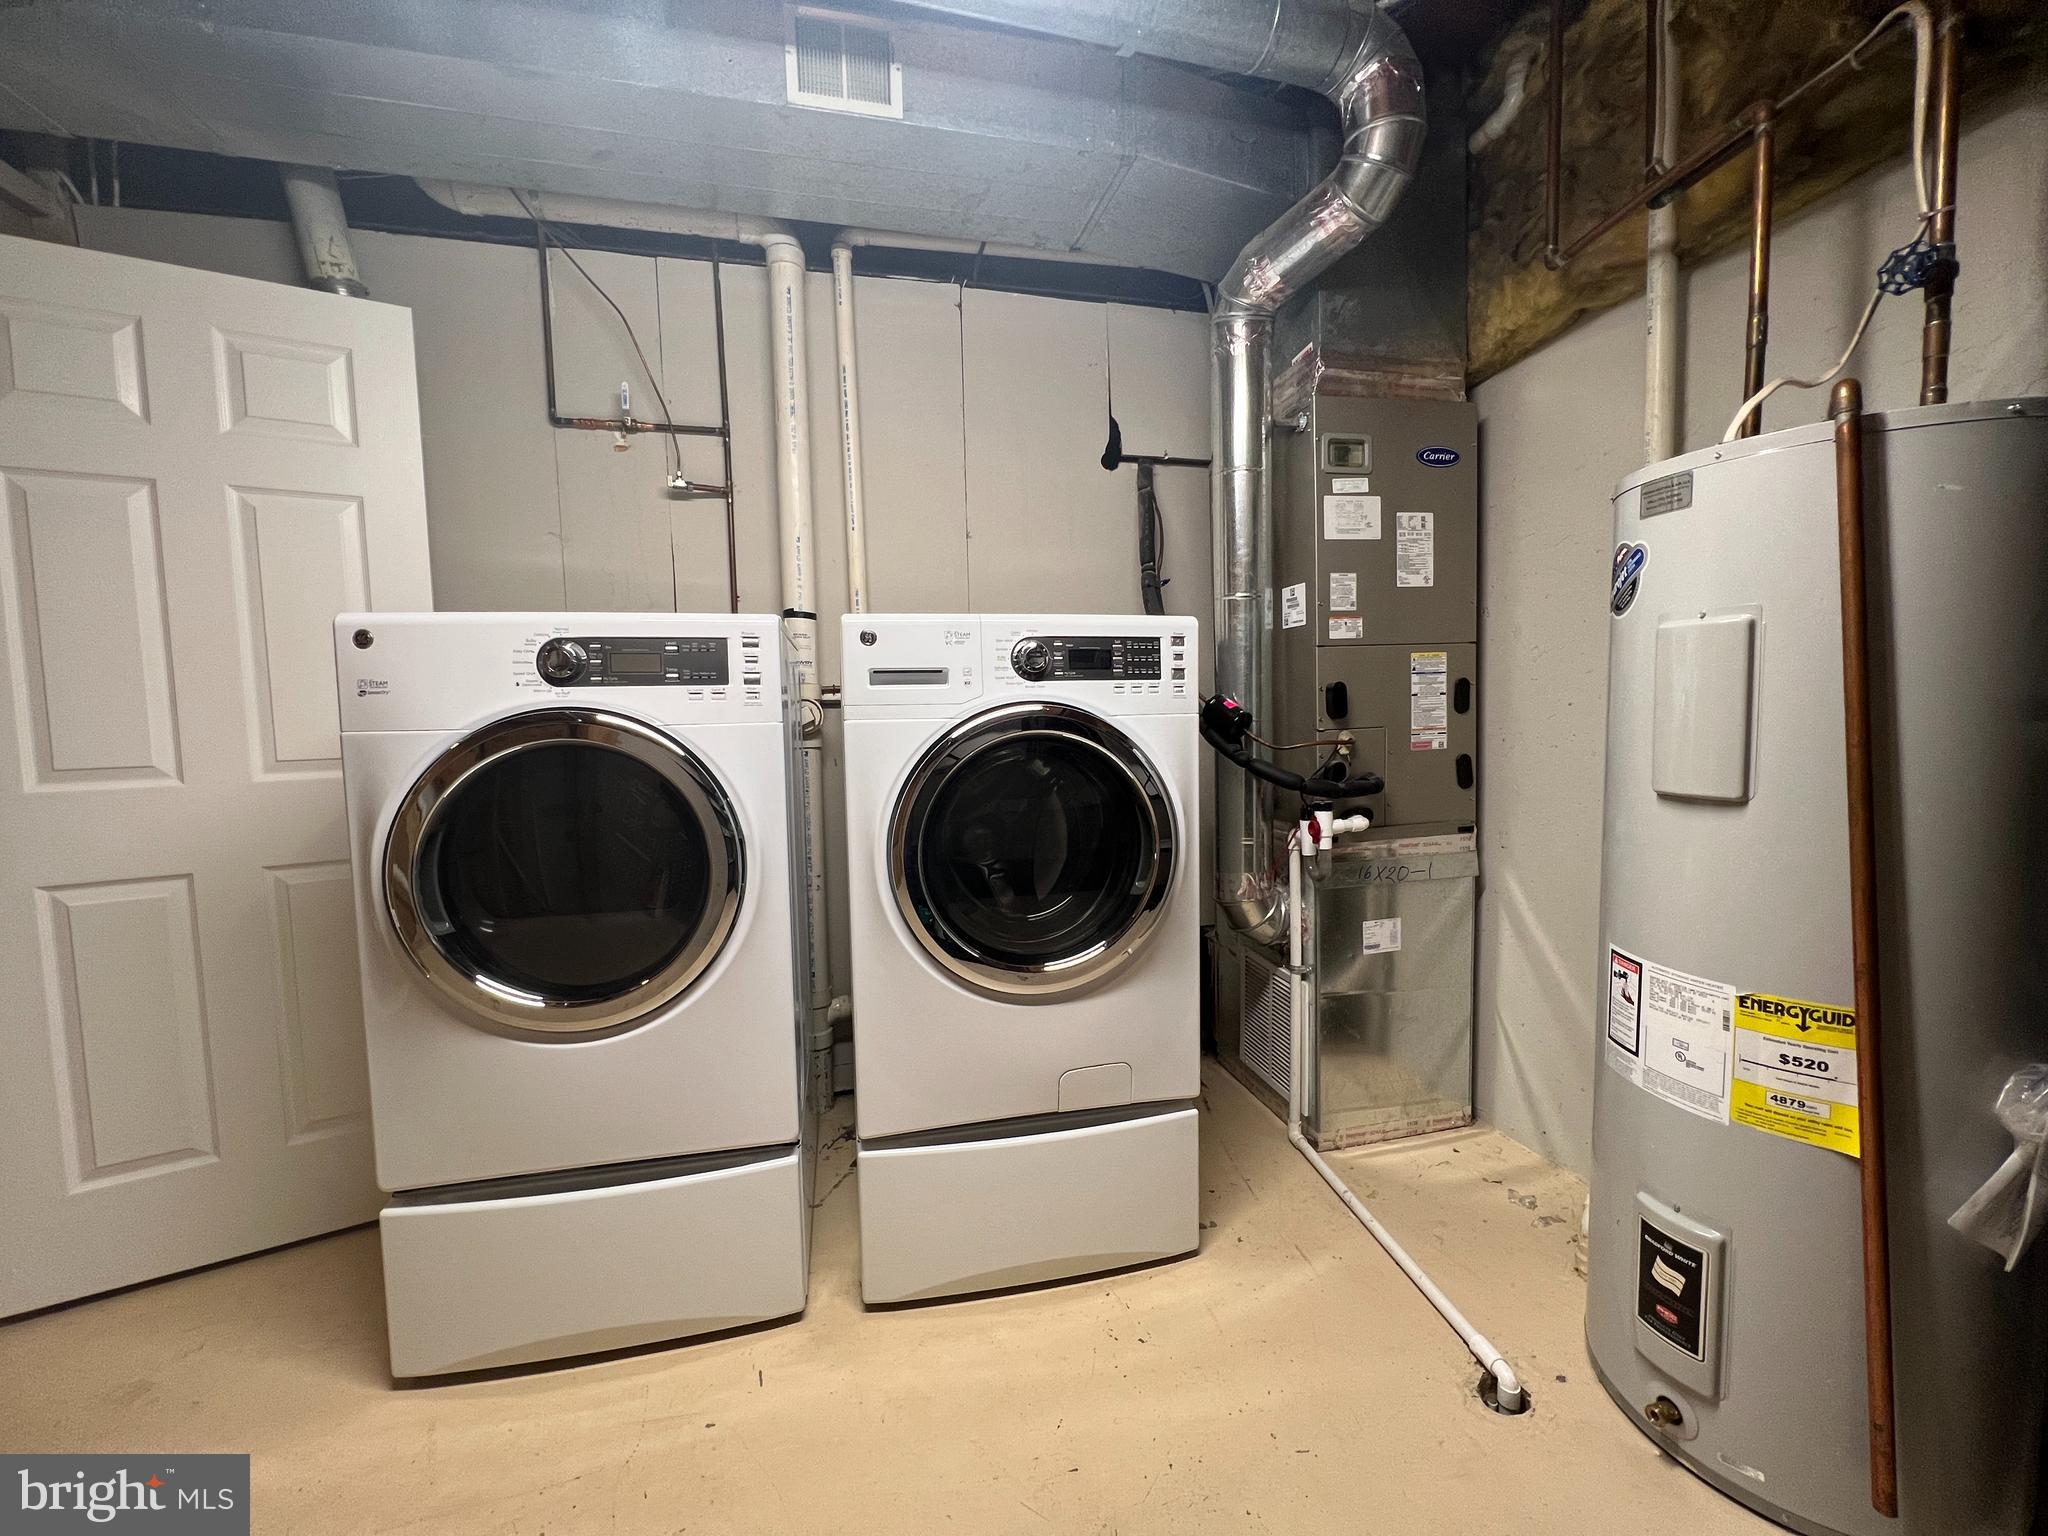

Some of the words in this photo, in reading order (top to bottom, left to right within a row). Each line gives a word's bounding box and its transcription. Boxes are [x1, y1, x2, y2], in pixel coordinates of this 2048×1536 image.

[1422, 450, 1456, 462] Carrier
[368, 679, 388, 687] STEAM
[1739, 995, 1856, 1030] ENERGYGUID
[1778, 1053, 1830, 1073] $520
[1770, 1094, 1806, 1109] 4879
[1644, 1234, 1674, 1257] BRADFORD
[1674, 1253, 1698, 1269] WHITE
